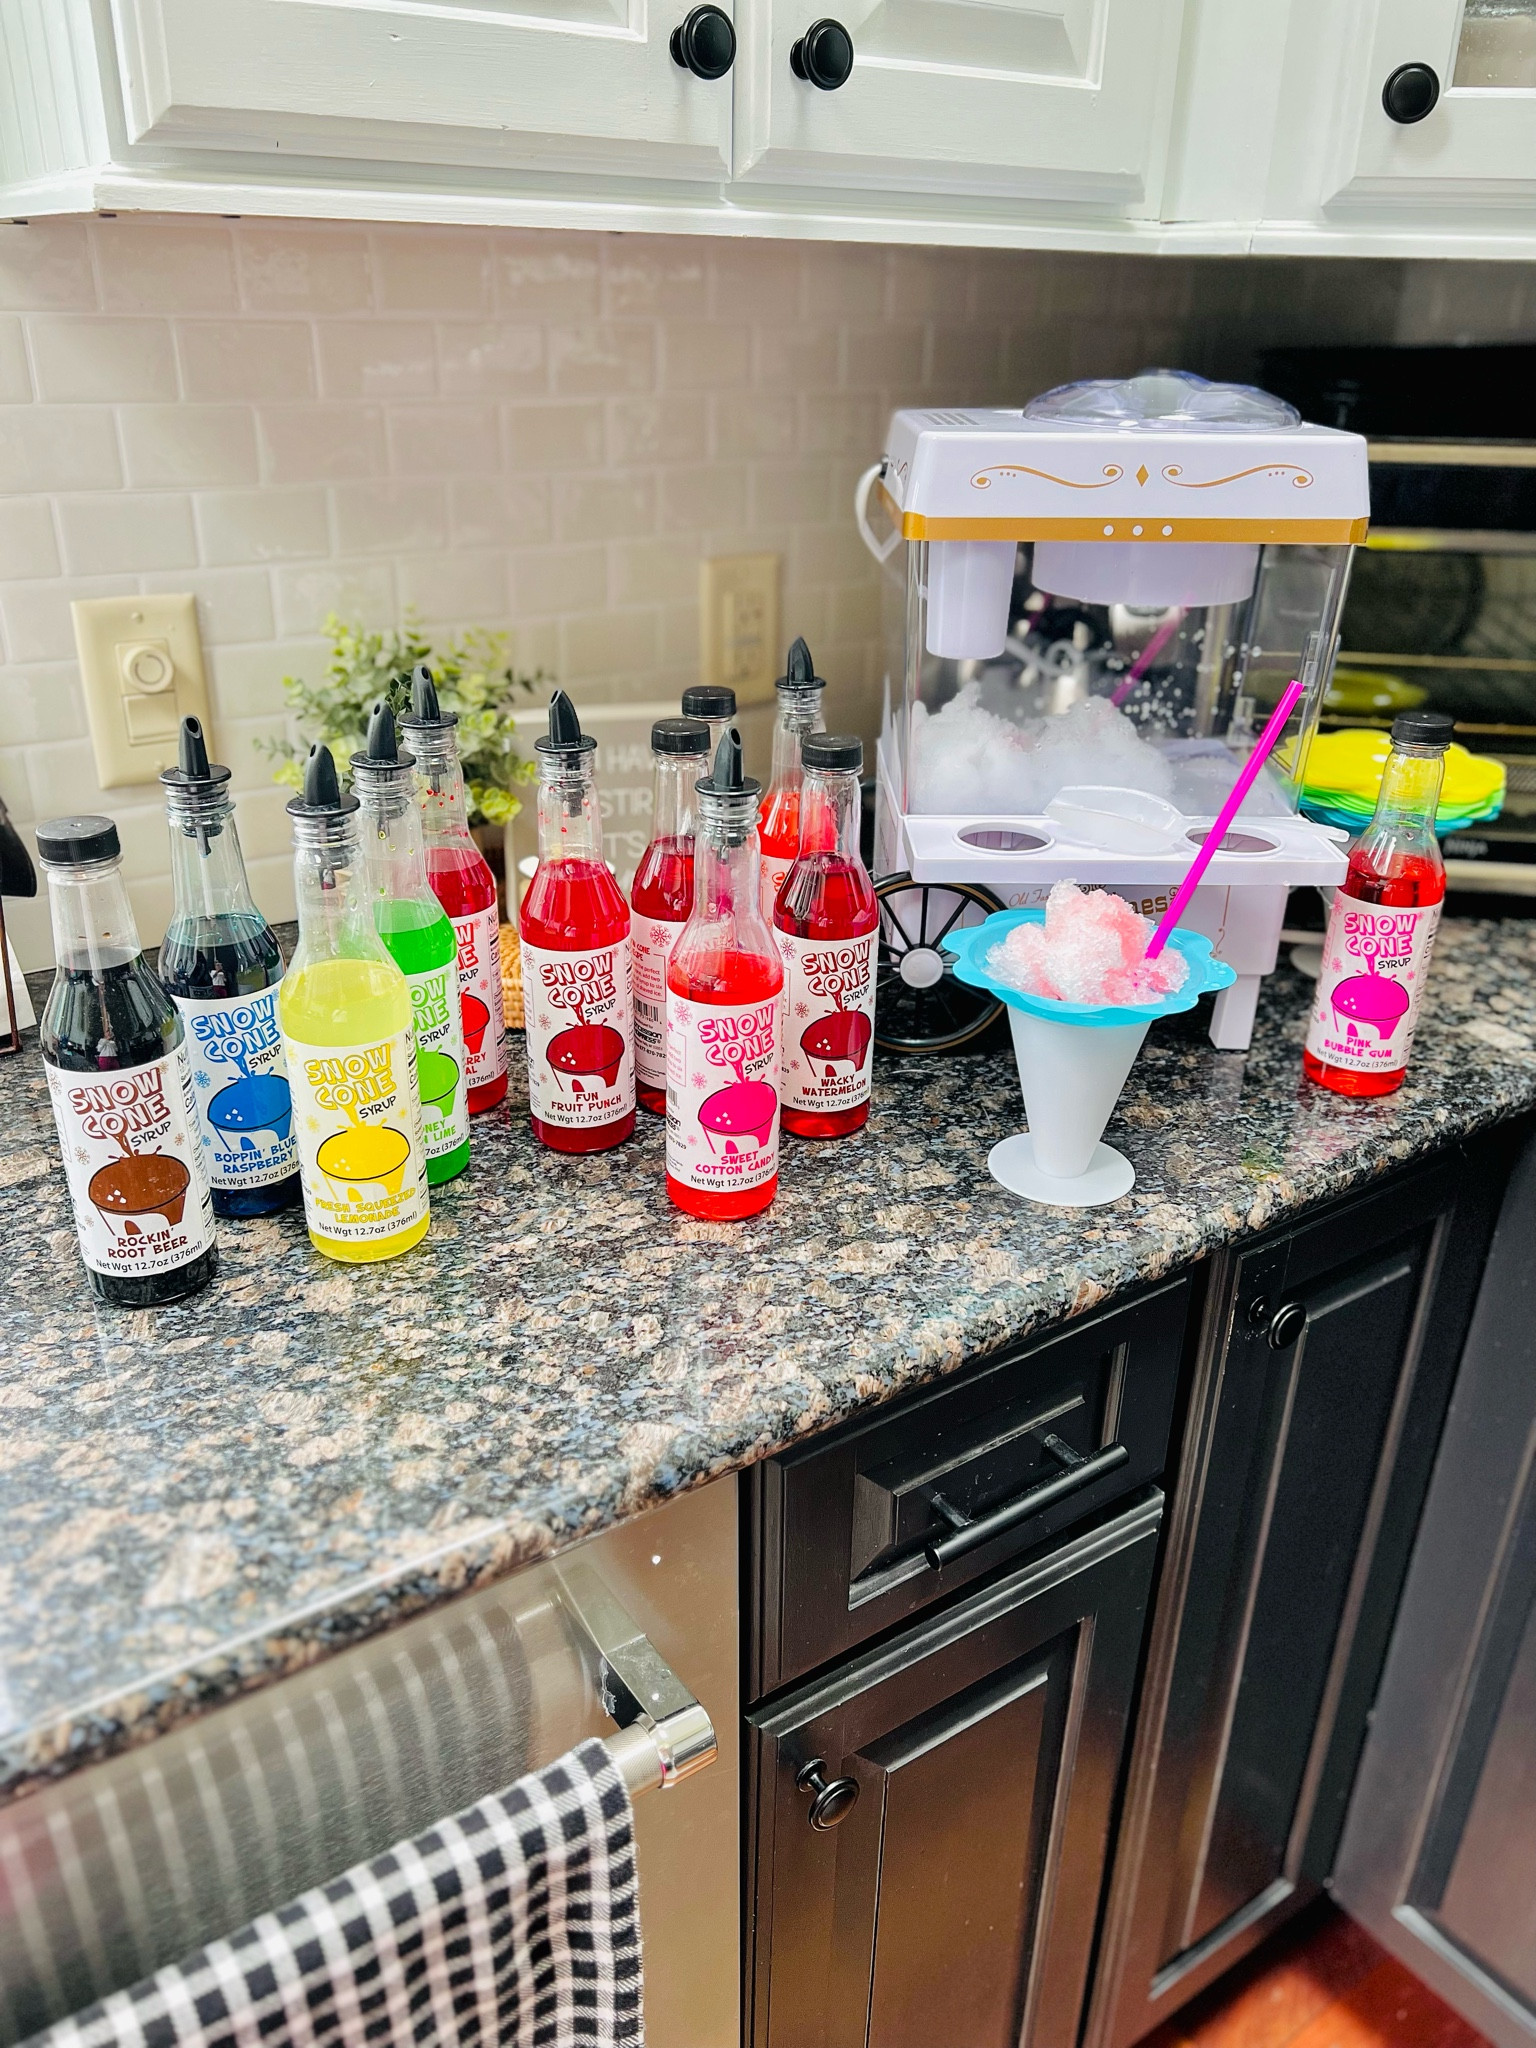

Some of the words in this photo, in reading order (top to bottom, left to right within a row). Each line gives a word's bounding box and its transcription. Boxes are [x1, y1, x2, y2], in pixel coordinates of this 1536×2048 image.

[1344, 912, 1417, 936] SNOW
[801, 938, 870, 976] SNOW
[1345, 935, 1413, 958] CONE
[459, 968, 479, 982] RUP
[539, 951, 613, 987] SNOW
[1378, 957, 1411, 970] SYRUP
[808, 962, 870, 996] CONE
[547, 974, 616, 1009] CONE
[843, 984, 870, 1005] SYRUP
[191, 994, 275, 1041] SNOW
[585, 999, 616, 1018] SYRUP
[420, 1023, 450, 1046] SYRUP
[698, 1003, 774, 1044] SNOW
[204, 1019, 281, 1063] CONE
[705, 1028, 775, 1067] CONE
[1324, 1039, 1364, 1057] BUBBLE
[1369, 1049, 1393, 1058] GUM
[1346, 1036, 1371, 1048] PINK
[249, 1044, 282, 1069] SYRUP
[304, 1043, 391, 1087] SNOW
[745, 1052, 774, 1075] SYRUP
[1316, 1047, 1327, 1058] Net
[1328, 1053, 1343, 1064] Wgt
[1344, 1058, 1371, 1068] 12.7oz
[315, 1069, 397, 1111] CONE
[469, 1071, 494, 1086] (376ml)
[802, 1078, 866, 1096] WATERMELON
[821, 1074, 855, 1087] WACKY
[67, 1067, 164, 1115] SNOW
[575, 1092, 599, 1102] FUN
[793, 1096, 806, 1105] Net
[808, 1100, 824, 1108] Wgt
[827, 1099, 850, 1107] 12.7oz
[359, 1095, 397, 1119] SYRUP
[544, 1110, 557, 1121] Net
[557, 1113, 574, 1124] Wgt
[576, 1113, 603, 1123] 12.7oz
[604, 1104, 628, 1121] (376ml)
[551, 1100, 584, 1112] FRUIT
[588, 1094, 621, 1111] PUNCH
[81, 1093, 171, 1140] CONE
[130, 1121, 171, 1147] SYRUP
[433, 1125, 456, 1141] LIME
[214, 1149, 266, 1163] BOPPIN'
[271, 1135, 297, 1155] BLUE
[720, 1150, 759, 1165] SWEET
[223, 1148, 293, 1174] RASPBERRY
[695, 1164, 743, 1175] COTTON
[748, 1152, 775, 1172] CANDY
[211, 1176, 226, 1186] Net
[226, 1176, 247, 1187] Wgt
[249, 1170, 280, 1184] 12.7oz
[691, 1174, 706, 1186] Net
[706, 1176, 725, 1188] Wgt
[727, 1174, 754, 1186] 12.7oz
[315, 1197, 350, 1213] FRESH
[356, 1187, 416, 1213] SQUEEZED
[319, 1222, 332, 1232] Net
[333, 1226, 352, 1237] Wgt
[355, 1226, 386, 1235] 12.7oz
[388, 1211, 418, 1231] (376ml)
[334, 1206, 400, 1223] LEMONADE
[108, 1247, 146, 1259] ROOT
[153, 1235, 188, 1254] BEER
[118, 1227, 174, 1247] ROCKIN'
[95, 1258, 110, 1270] Net
[110, 1261, 131, 1273] Wgt
[135, 1259, 169, 1271] 12.7oz
[170, 1241, 203, 1264] (376ml)
